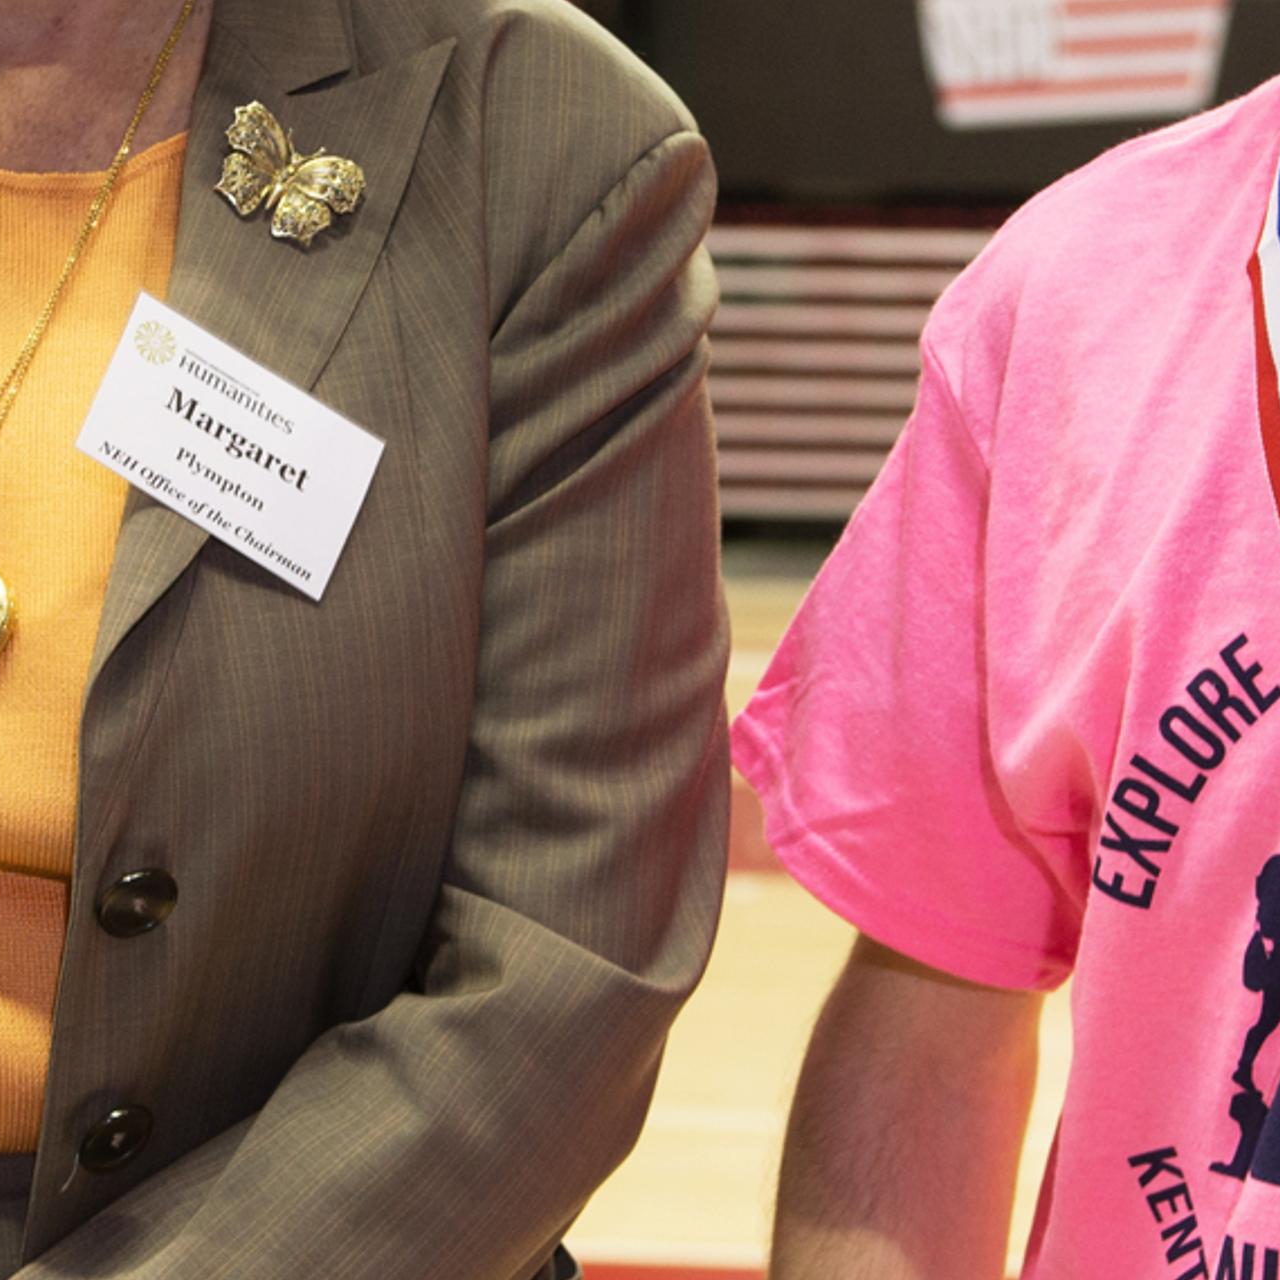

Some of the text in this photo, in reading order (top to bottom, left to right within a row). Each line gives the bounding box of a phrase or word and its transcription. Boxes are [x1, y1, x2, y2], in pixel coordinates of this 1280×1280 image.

[165, 384, 310, 494] Margaret
[179, 354, 295, 435] Humanities
[99, 440, 313, 582] NEH Office of the Chairman
[176, 447, 265, 512] Plympton
